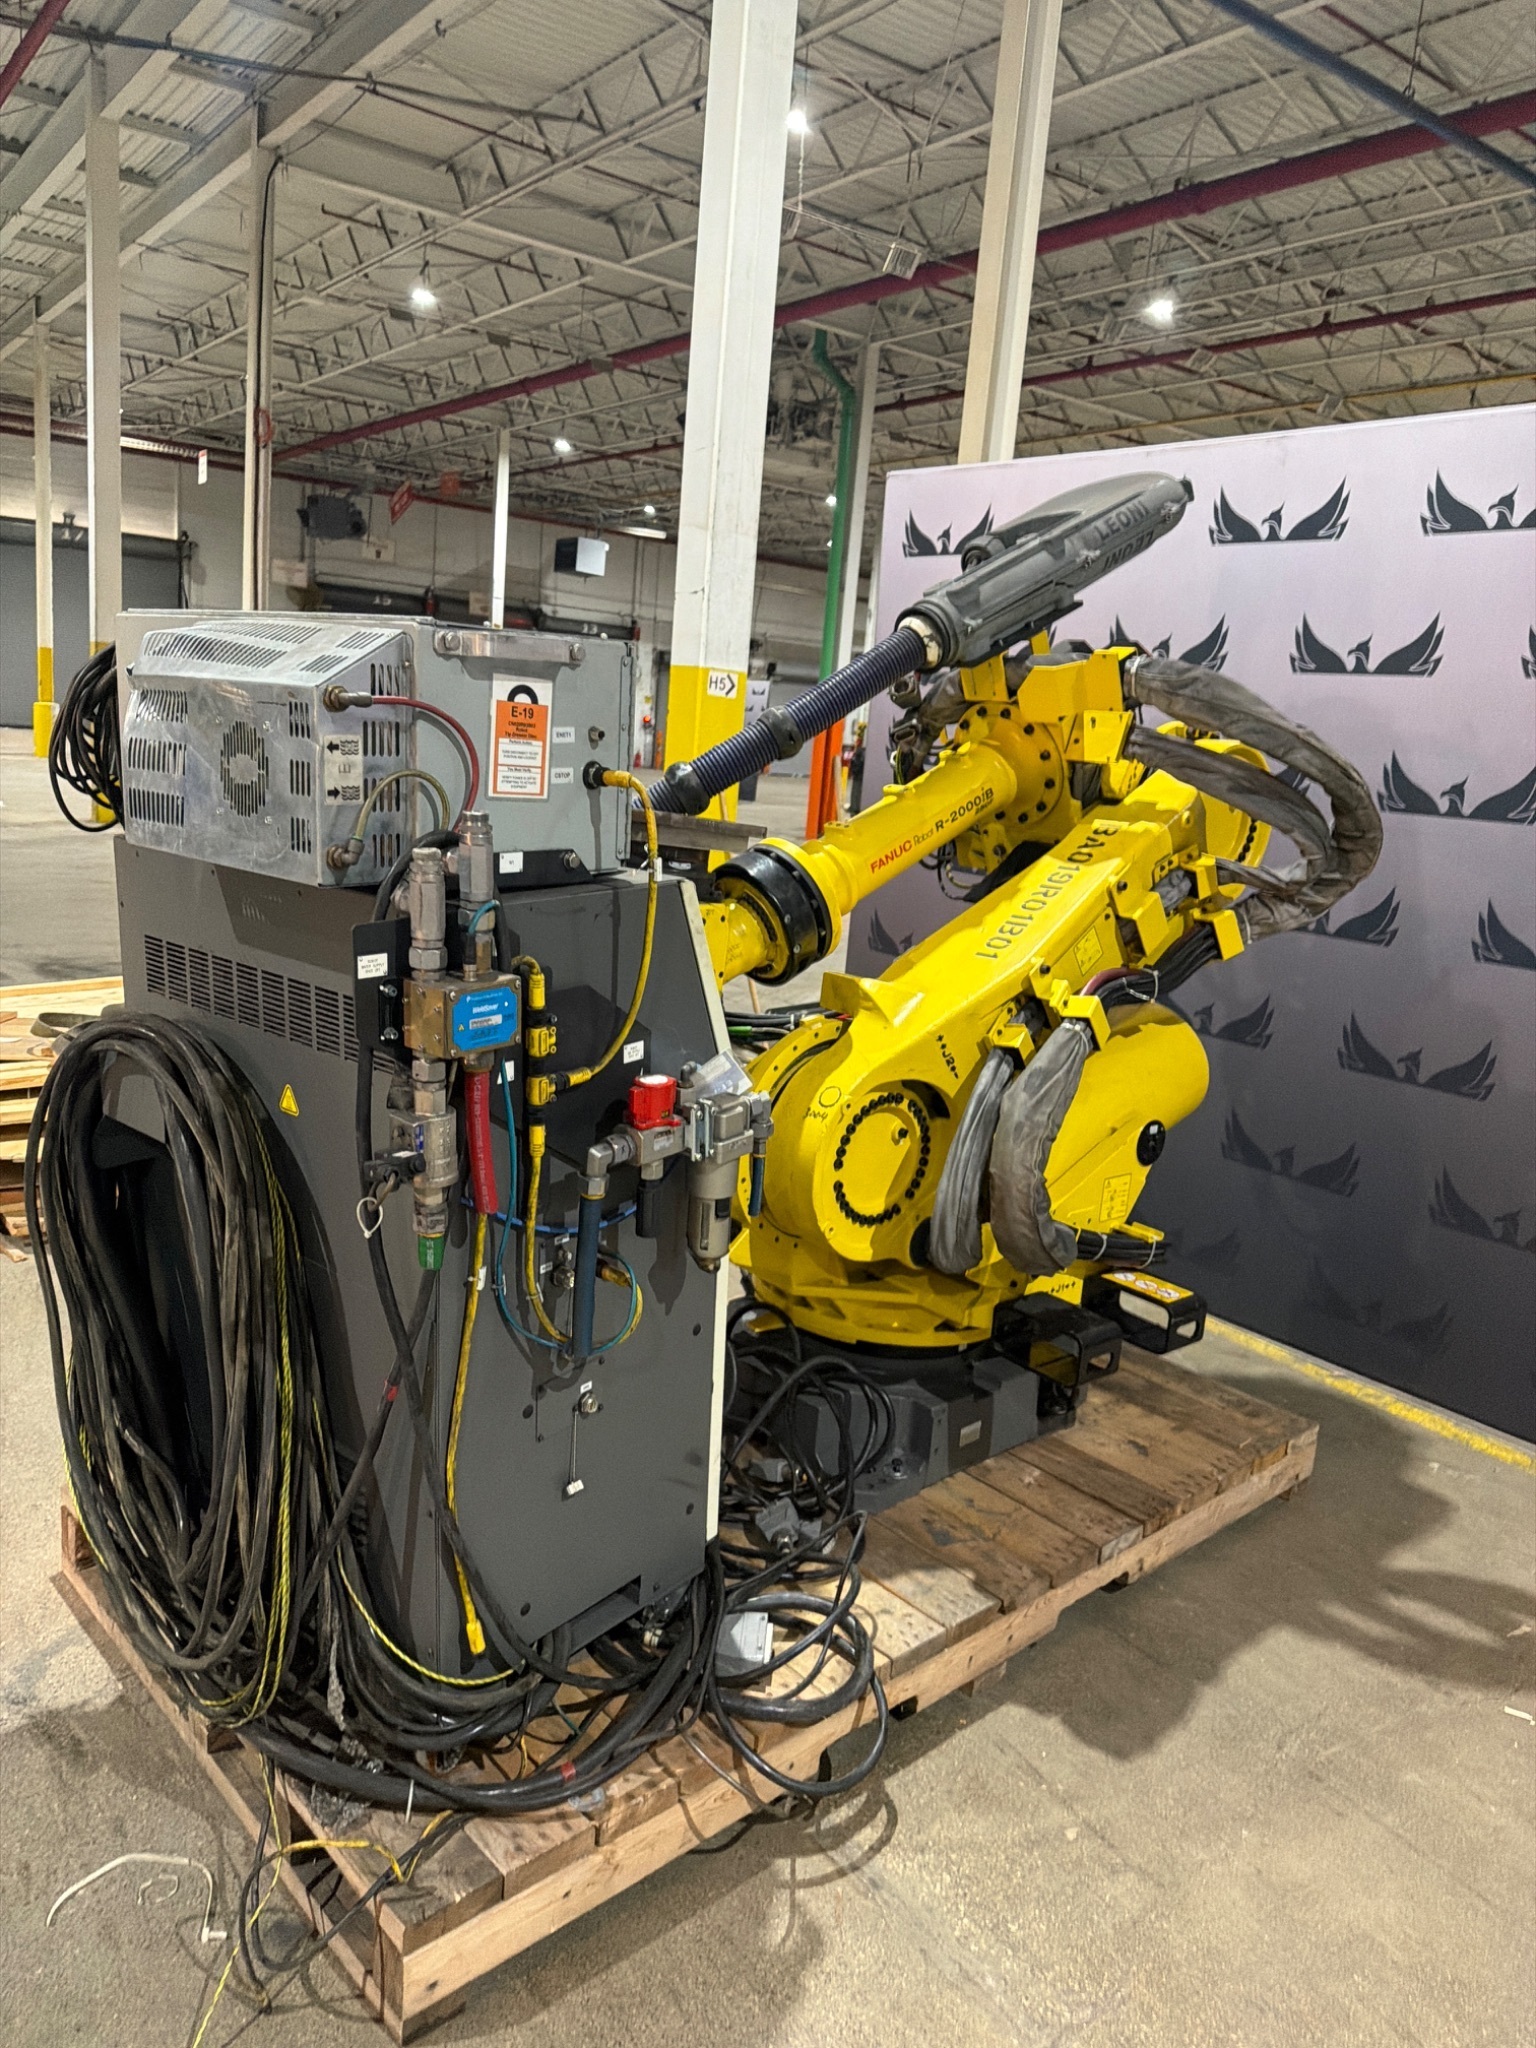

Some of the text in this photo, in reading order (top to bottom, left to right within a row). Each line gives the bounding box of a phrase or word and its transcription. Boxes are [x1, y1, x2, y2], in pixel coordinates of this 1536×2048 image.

[1094, 501, 1150, 541] LEONI
[709, 675, 726, 691] H5
[511, 705, 534, 719] E-19
[870, 840, 913, 874] FANUC
[935, 787, 995, 832] R-2000iB
